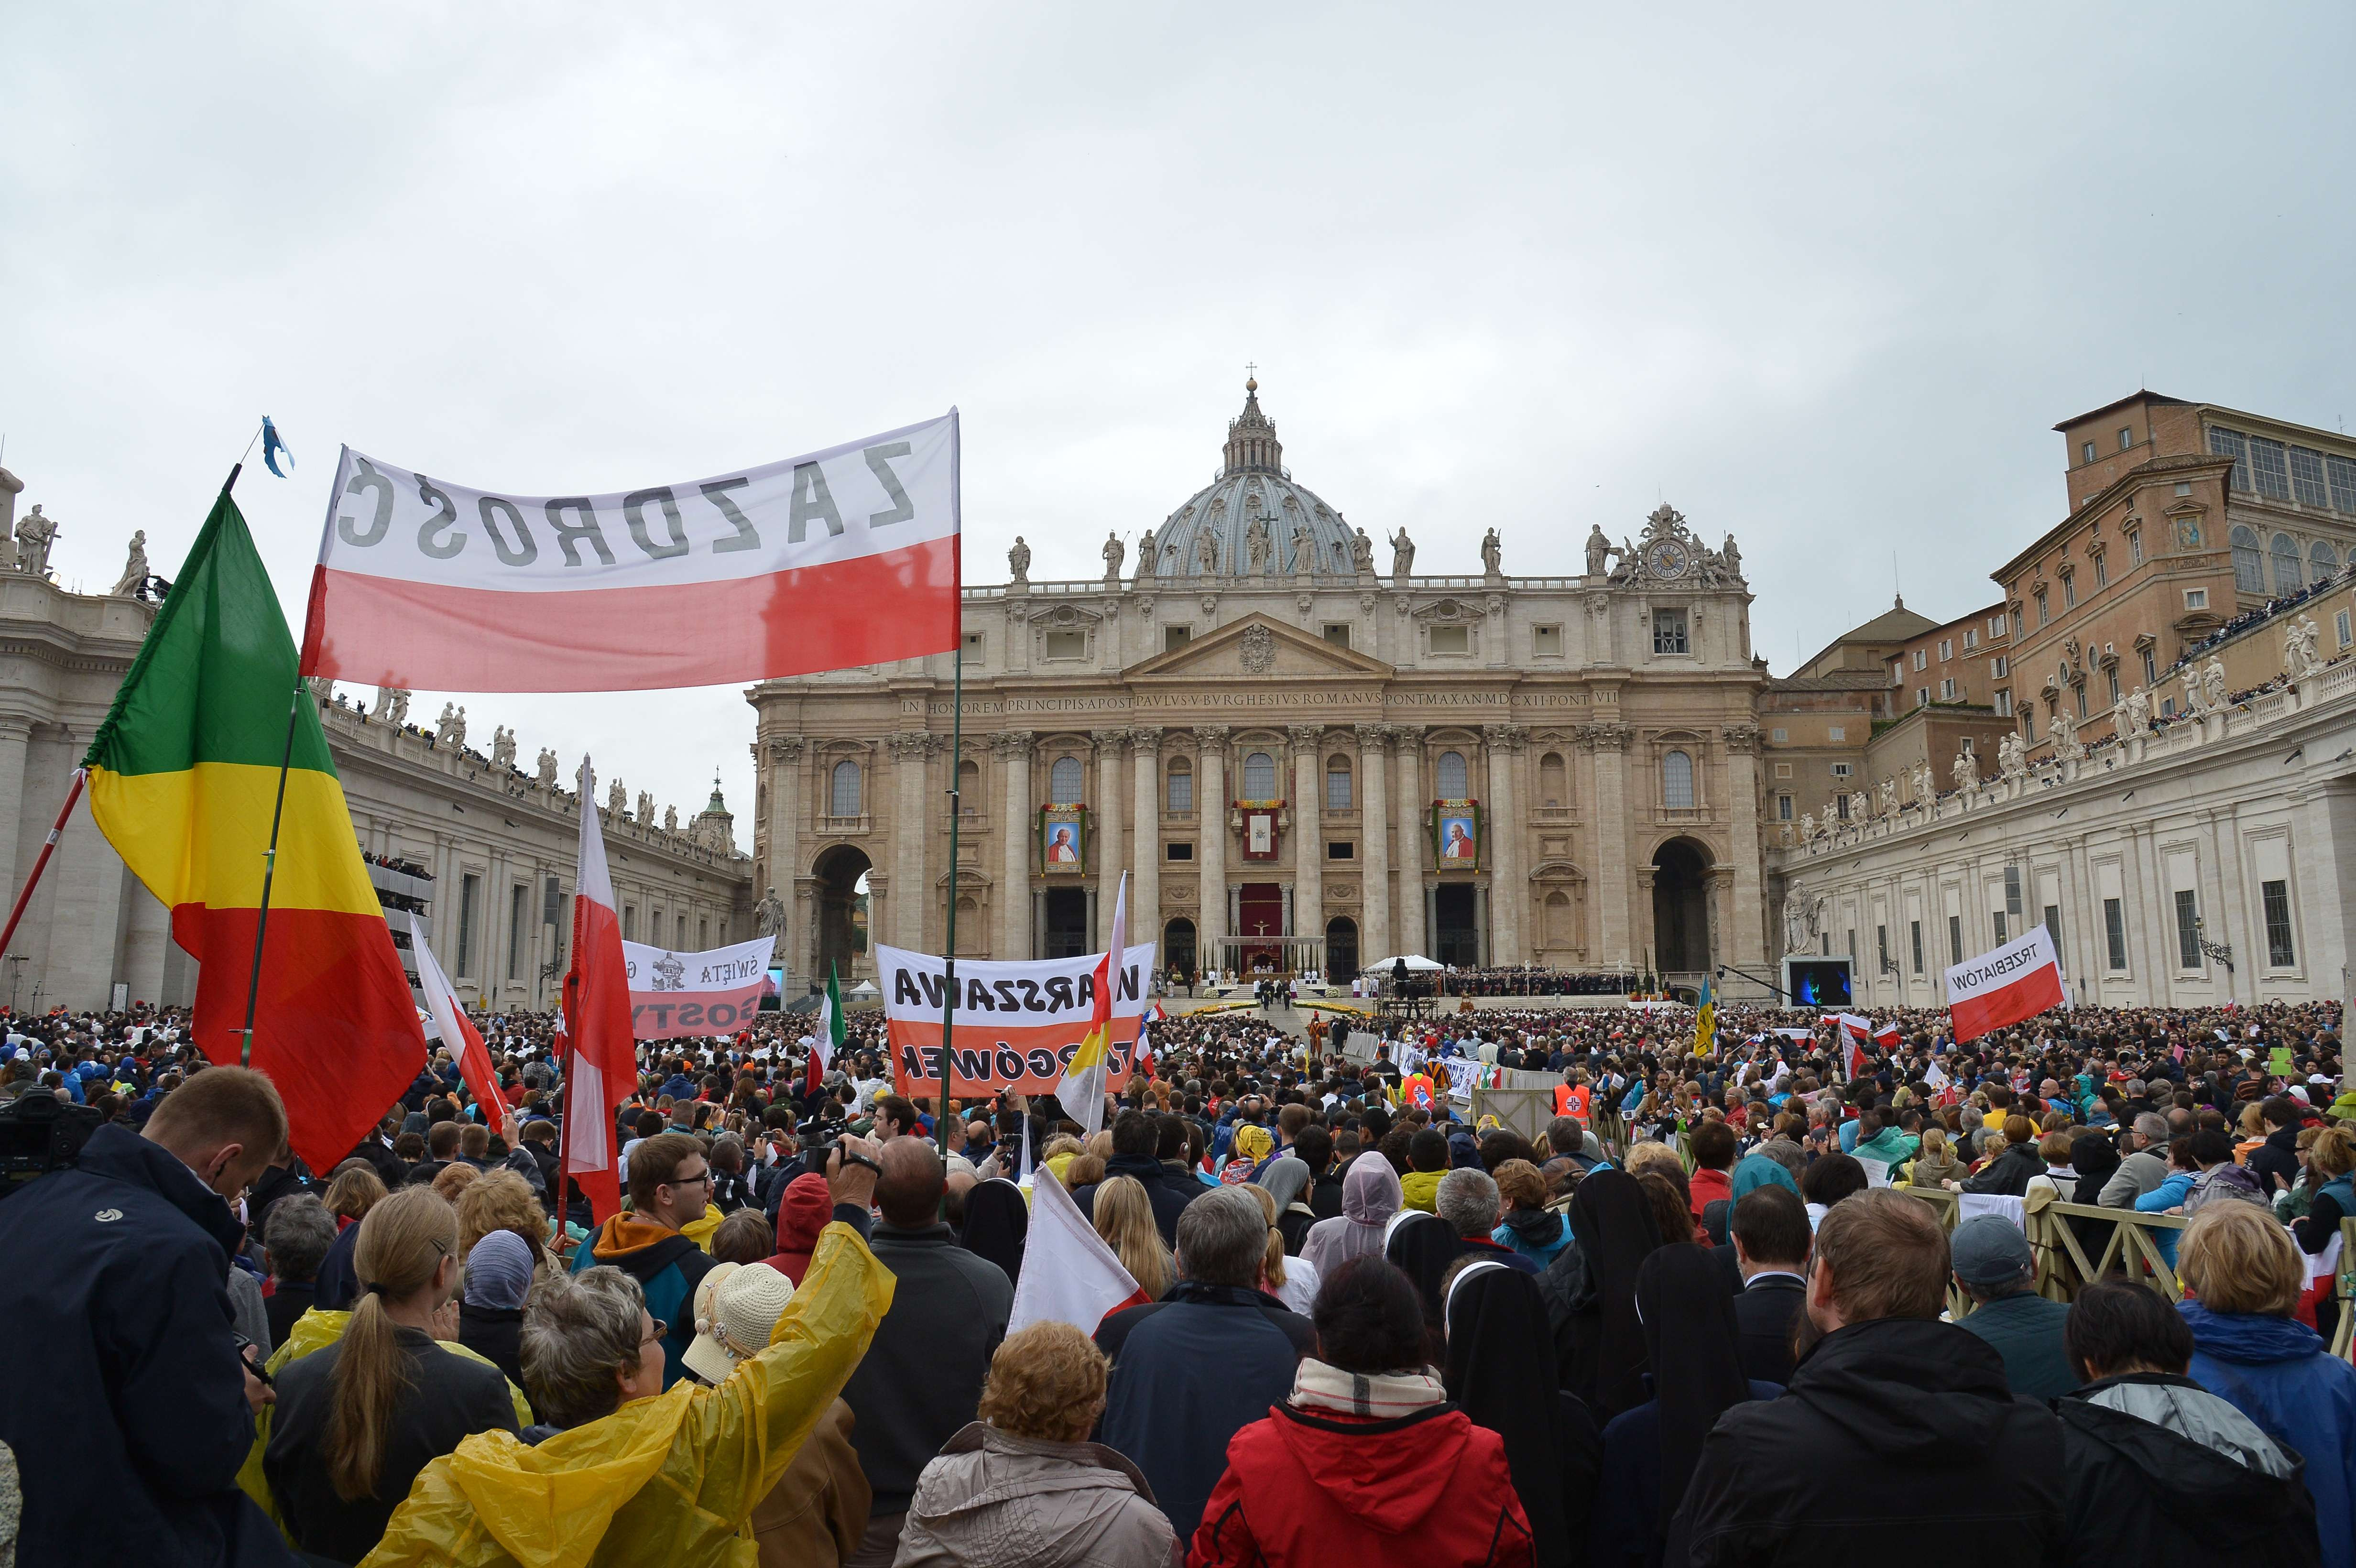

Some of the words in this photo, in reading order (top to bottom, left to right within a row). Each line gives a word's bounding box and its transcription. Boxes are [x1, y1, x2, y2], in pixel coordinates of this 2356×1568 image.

[903, 701, 919, 712] IN
[1008, 699, 1084, 711] PRINCIPIS
[1087, 697, 1134, 709] APOST
[1136, 695, 1187, 707] PAVLVS
[1190, 695, 1201, 705] V
[1204, 694, 1298, 706] BVRGHESIVS
[1303, 692, 1382, 704] ROMANVS
[1385, 693, 1424, 705] PONT
[1425, 693, 1459, 705] MAX
[1461, 693, 1483, 705] AN
[1549, 695, 1589, 706] PONT
[1596, 692, 1618, 703] VII
